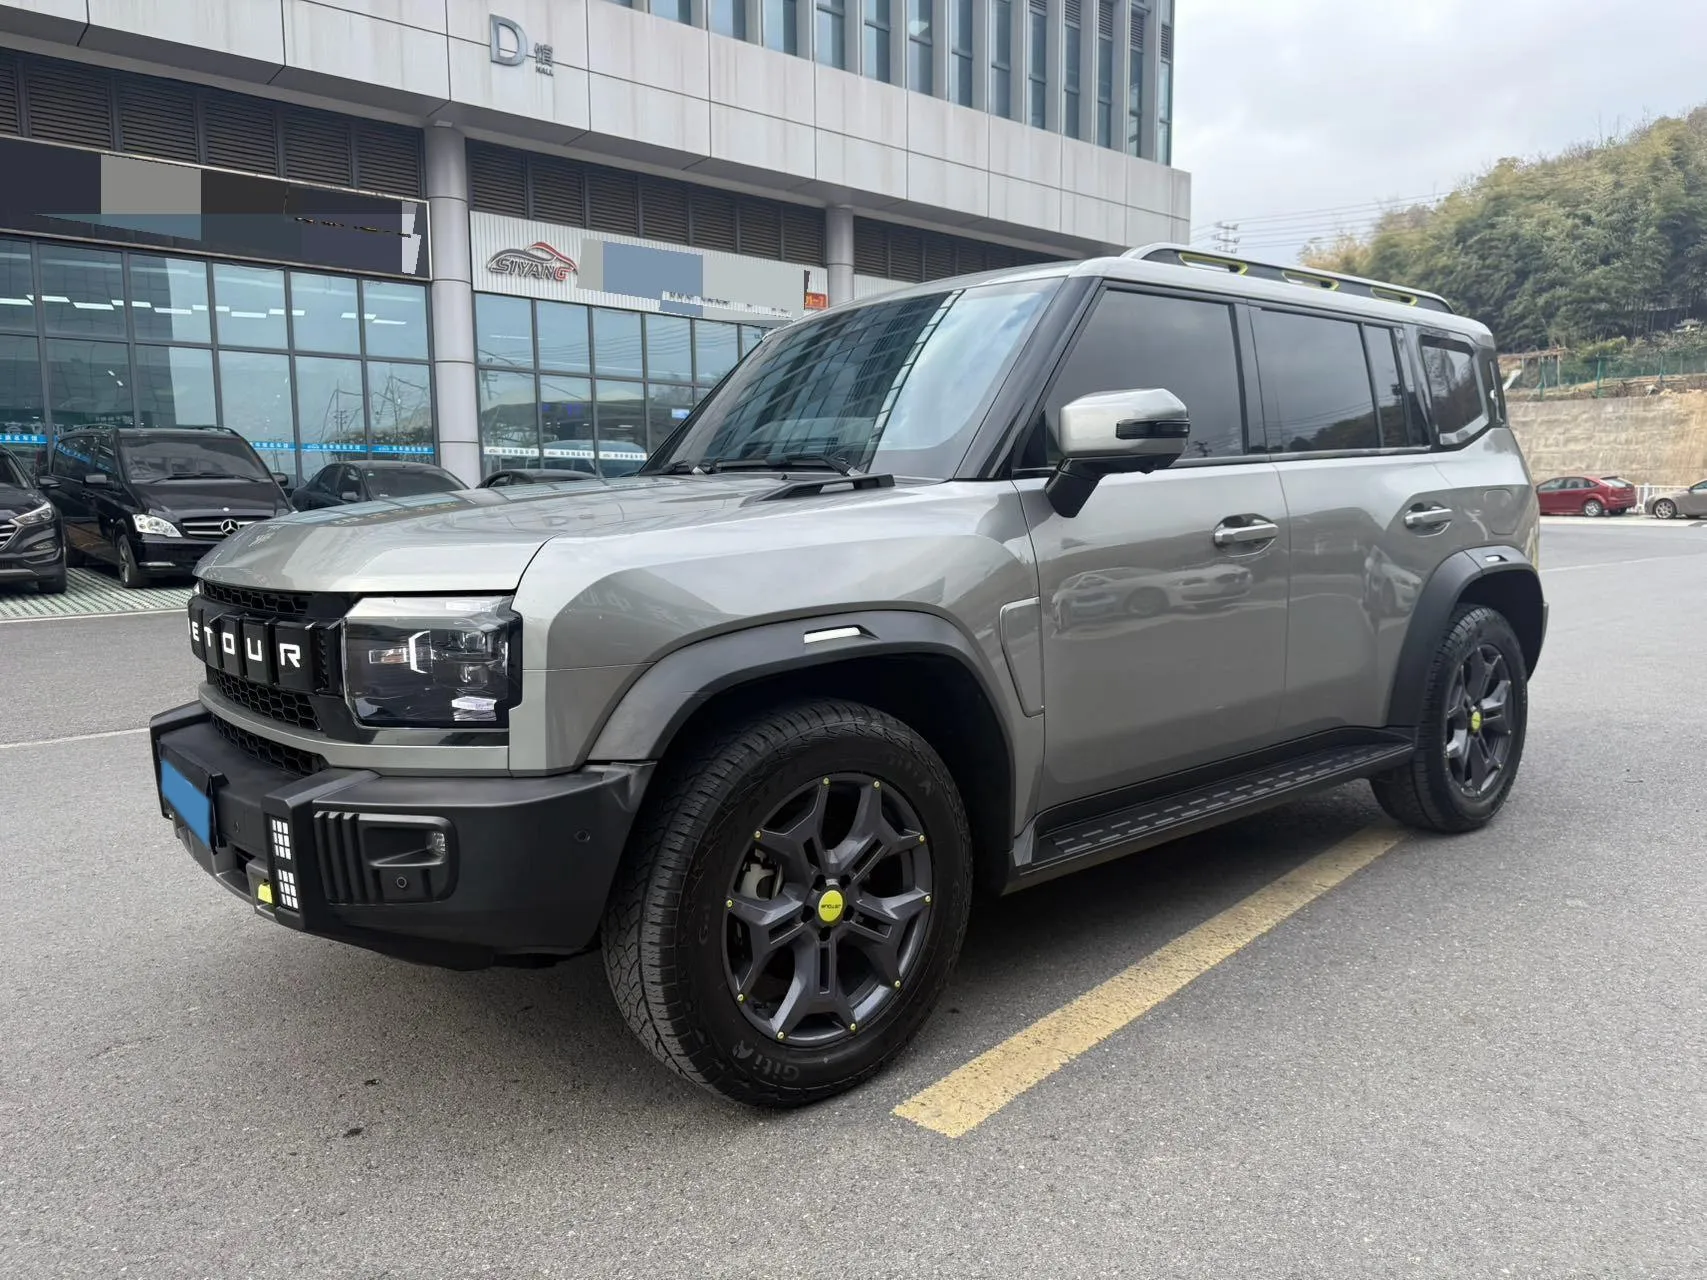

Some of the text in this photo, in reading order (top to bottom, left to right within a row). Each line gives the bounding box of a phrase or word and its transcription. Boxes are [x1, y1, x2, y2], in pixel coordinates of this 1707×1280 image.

[489, 13, 528, 67] D
[489, 258, 574, 281] SIYANG
[188, 617, 300, 668] ETOUR
